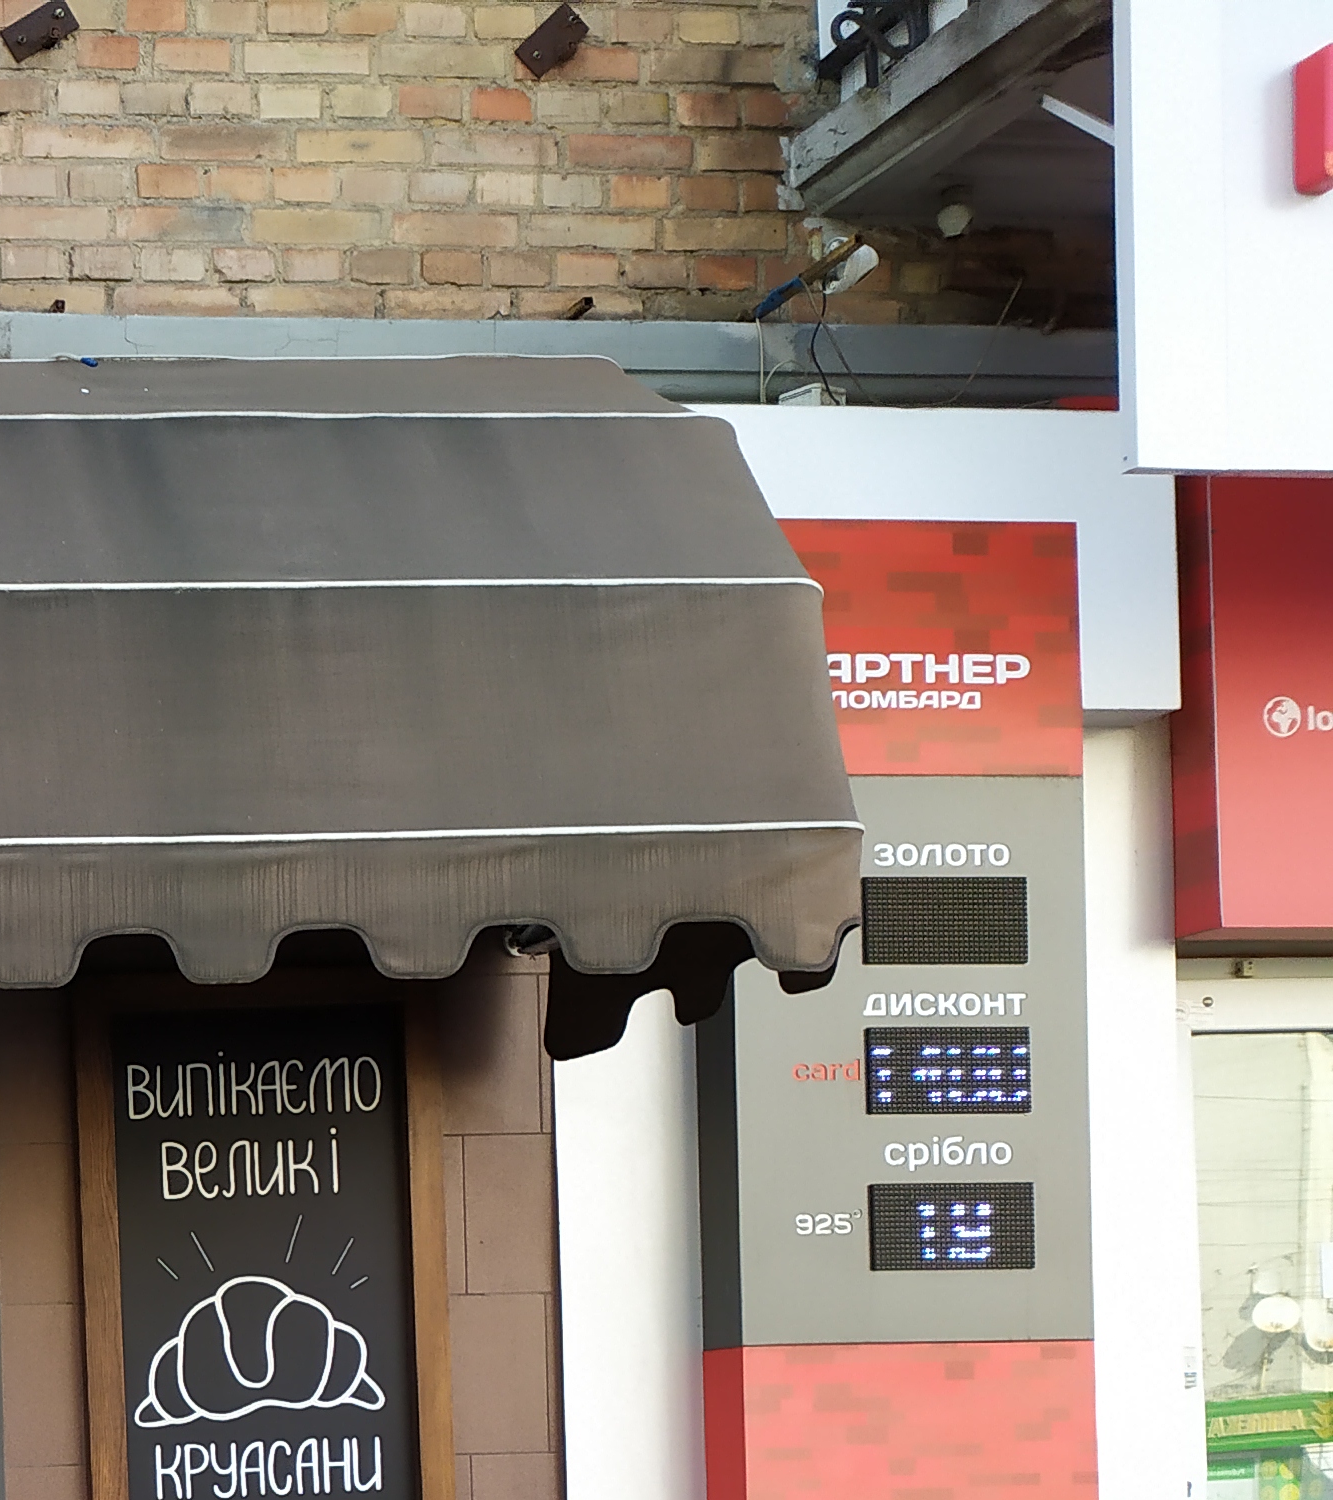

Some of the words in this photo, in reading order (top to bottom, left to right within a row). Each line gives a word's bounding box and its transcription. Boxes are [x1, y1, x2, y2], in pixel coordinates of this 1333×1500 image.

[874, 843, 1010, 867] ЗОЛОТО
[863, 992, 1027, 1016] ДИСКОНТ
[792, 1059, 861, 1081] card
[127, 1051, 381, 1120] ВИПІКАЄМО
[884, 1136, 1013, 1172] срібло
[155, 1436, 382, 1500] КРУАСАНИ
